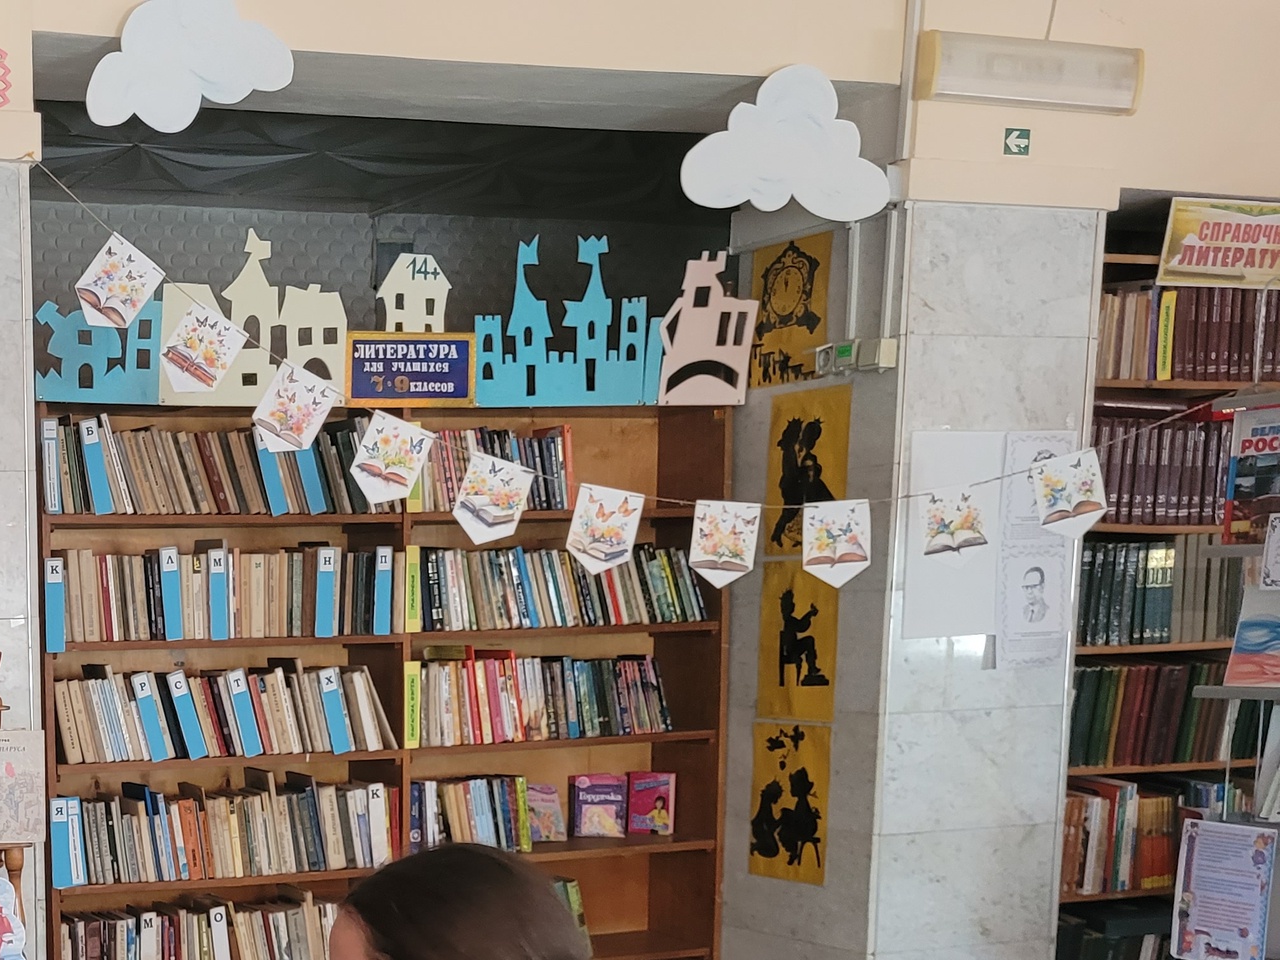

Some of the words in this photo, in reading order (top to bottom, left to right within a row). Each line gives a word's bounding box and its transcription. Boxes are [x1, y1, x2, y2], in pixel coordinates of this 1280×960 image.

[1178, 245, 1280, 269] ЛИТЕРАТУ
[406, 257, 440, 281] 14+
[354, 344, 458, 359] ЛИТЕРАТУРА
[363, 362, 383, 372] ДЛЯ
[391, 362, 449, 373] УЧАЩИХСЯ
[410, 382, 454, 392] КЛАССОВ
[85, 425, 95, 437] Б
[1241, 436, 1280, 454] РОС
[165, 555, 175, 565] Л
[213, 557, 223, 567] М
[322, 556, 333, 566] Н
[380, 554, 388, 564] П
[50, 565, 60, 576] К
[174, 680, 183, 691] С
[233, 677, 242, 688] Т
[324, 676, 335, 685] Х
[139, 682, 147, 692] Р
[370, 788, 380, 799] К
[54, 806, 65, 816] Я
[214, 912, 223, 923] О
[143, 918, 154, 929] М
